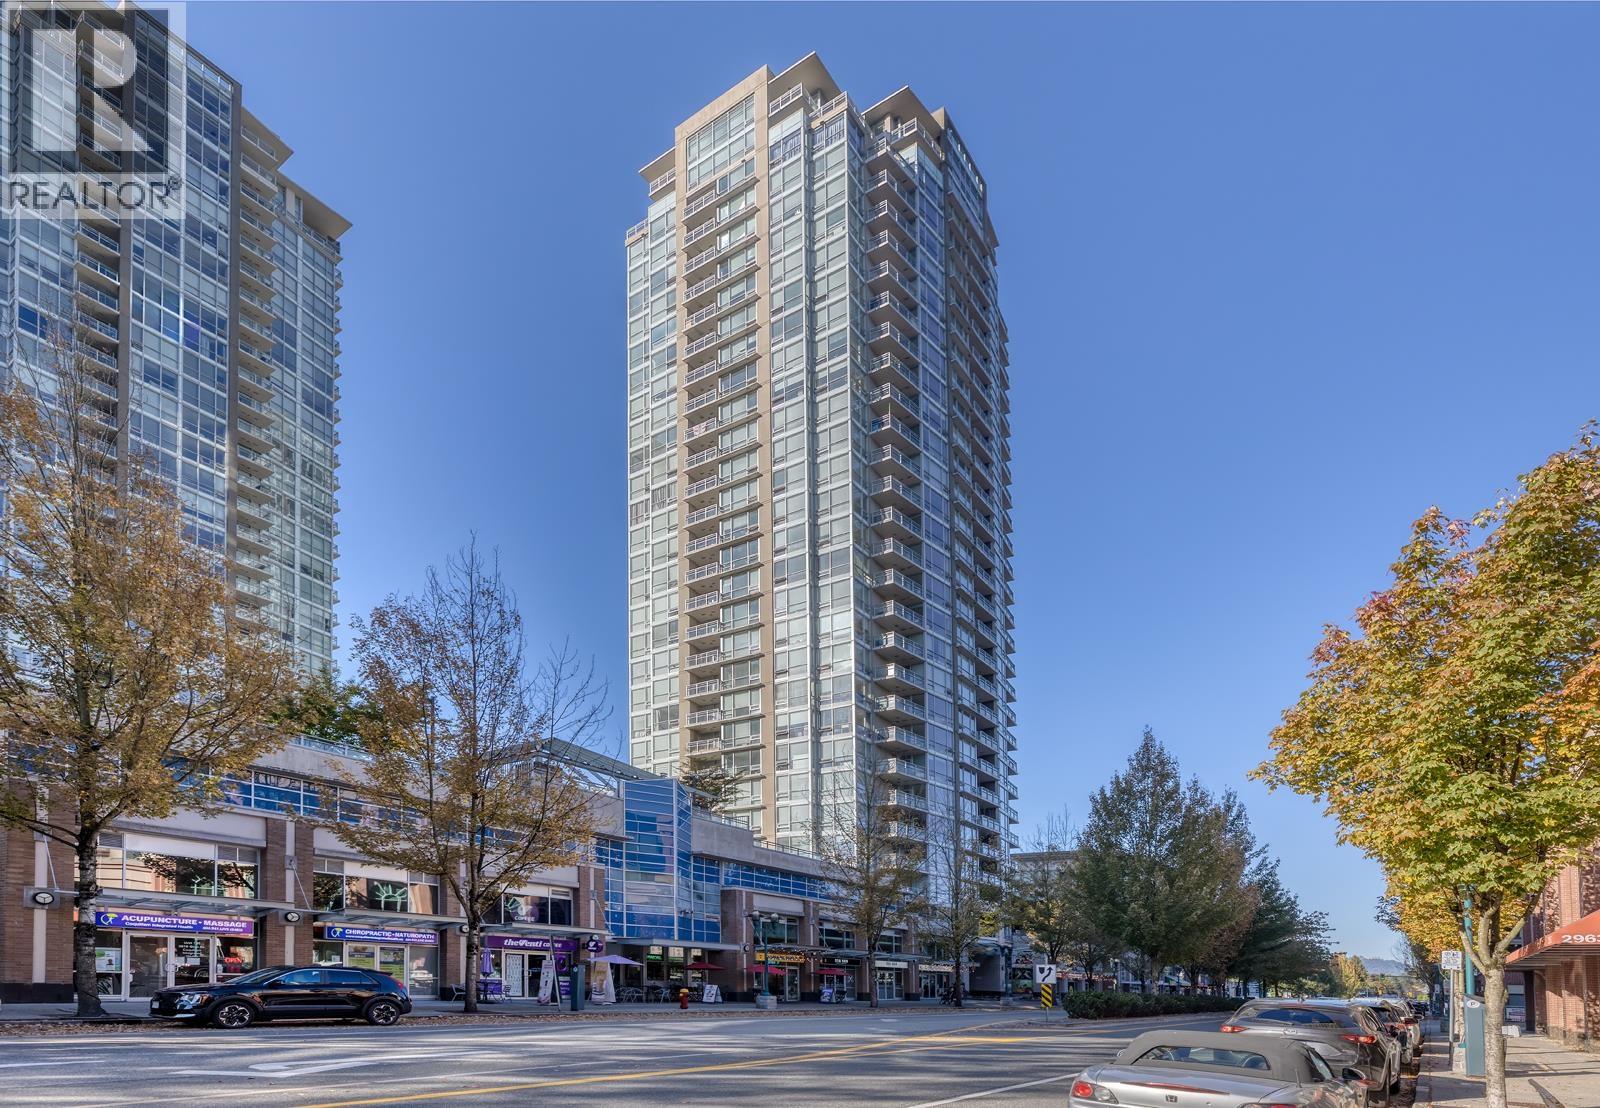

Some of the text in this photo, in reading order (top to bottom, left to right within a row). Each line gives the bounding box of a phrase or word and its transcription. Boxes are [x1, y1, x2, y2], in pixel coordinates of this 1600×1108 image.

[121, 914, 247, 928] ACUPUNCTURE MASSAGE
[224, 956, 243, 964] OPEN
